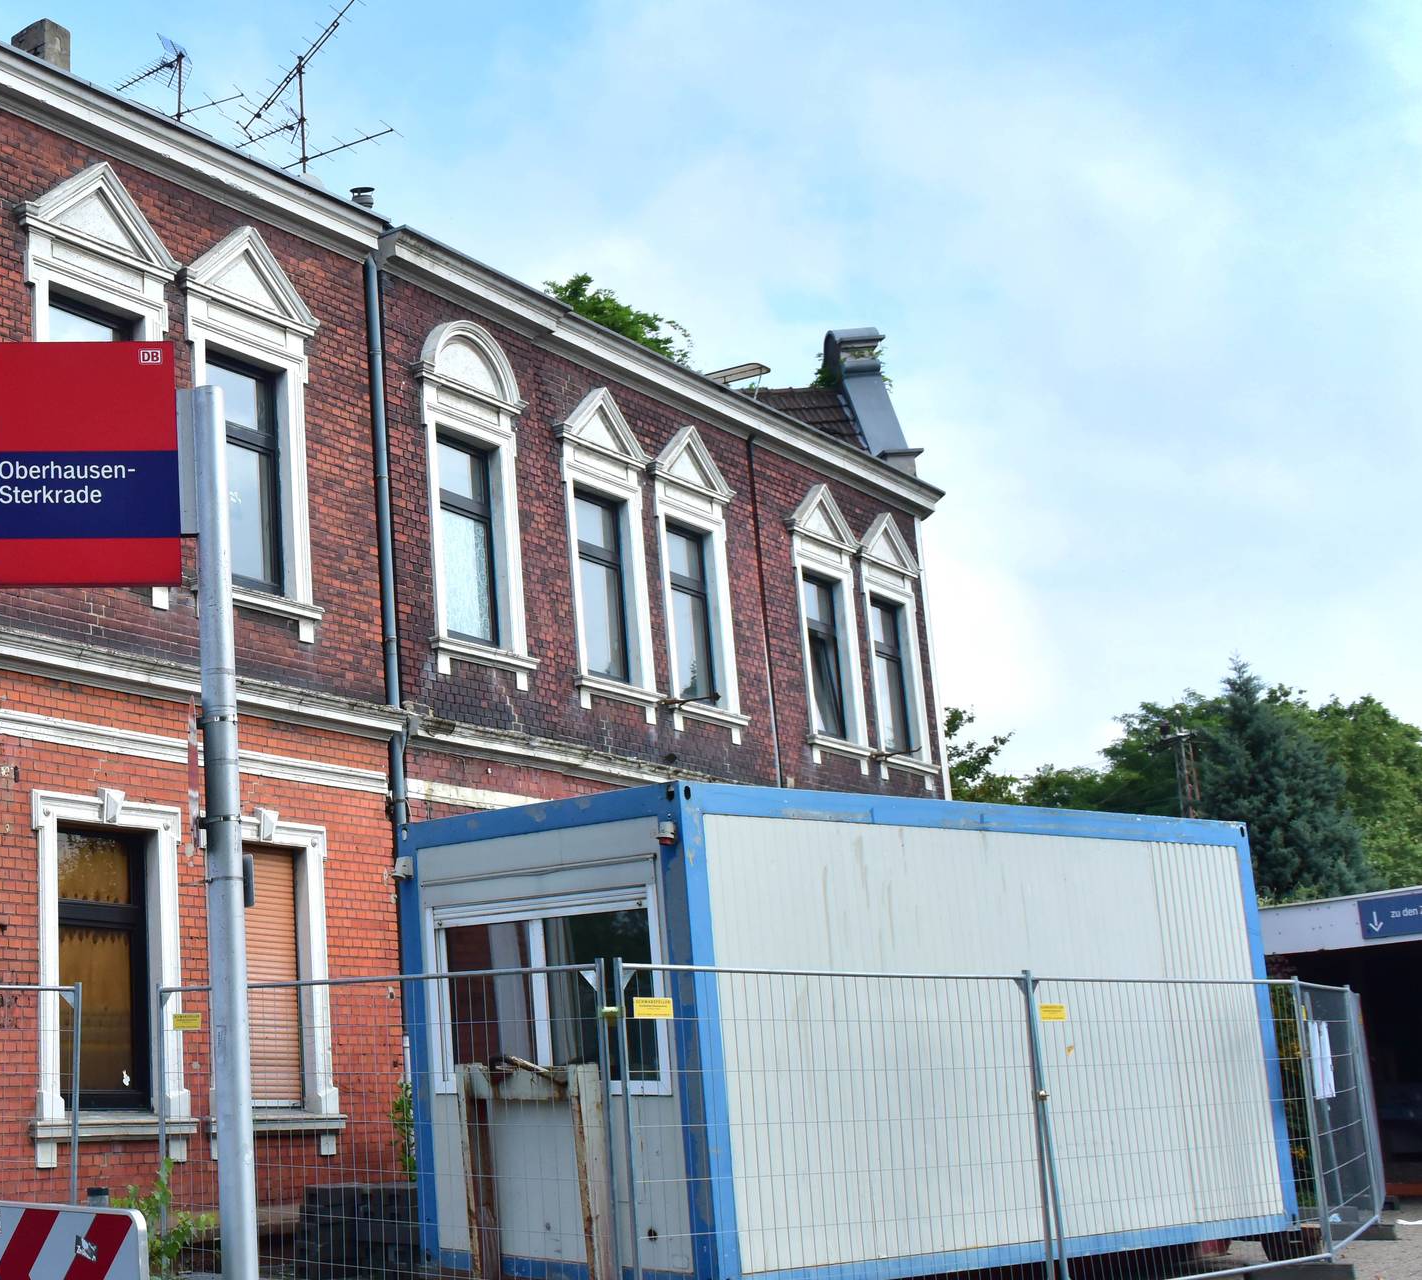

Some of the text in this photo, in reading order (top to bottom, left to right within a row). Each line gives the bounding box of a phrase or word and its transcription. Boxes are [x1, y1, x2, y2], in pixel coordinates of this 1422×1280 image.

[141, 351, 160, 363] DB
[0, 485, 102, 504] Sterkrade
[1390, 910, 1401, 918] zu
[1402, 907, 1418, 917] den
